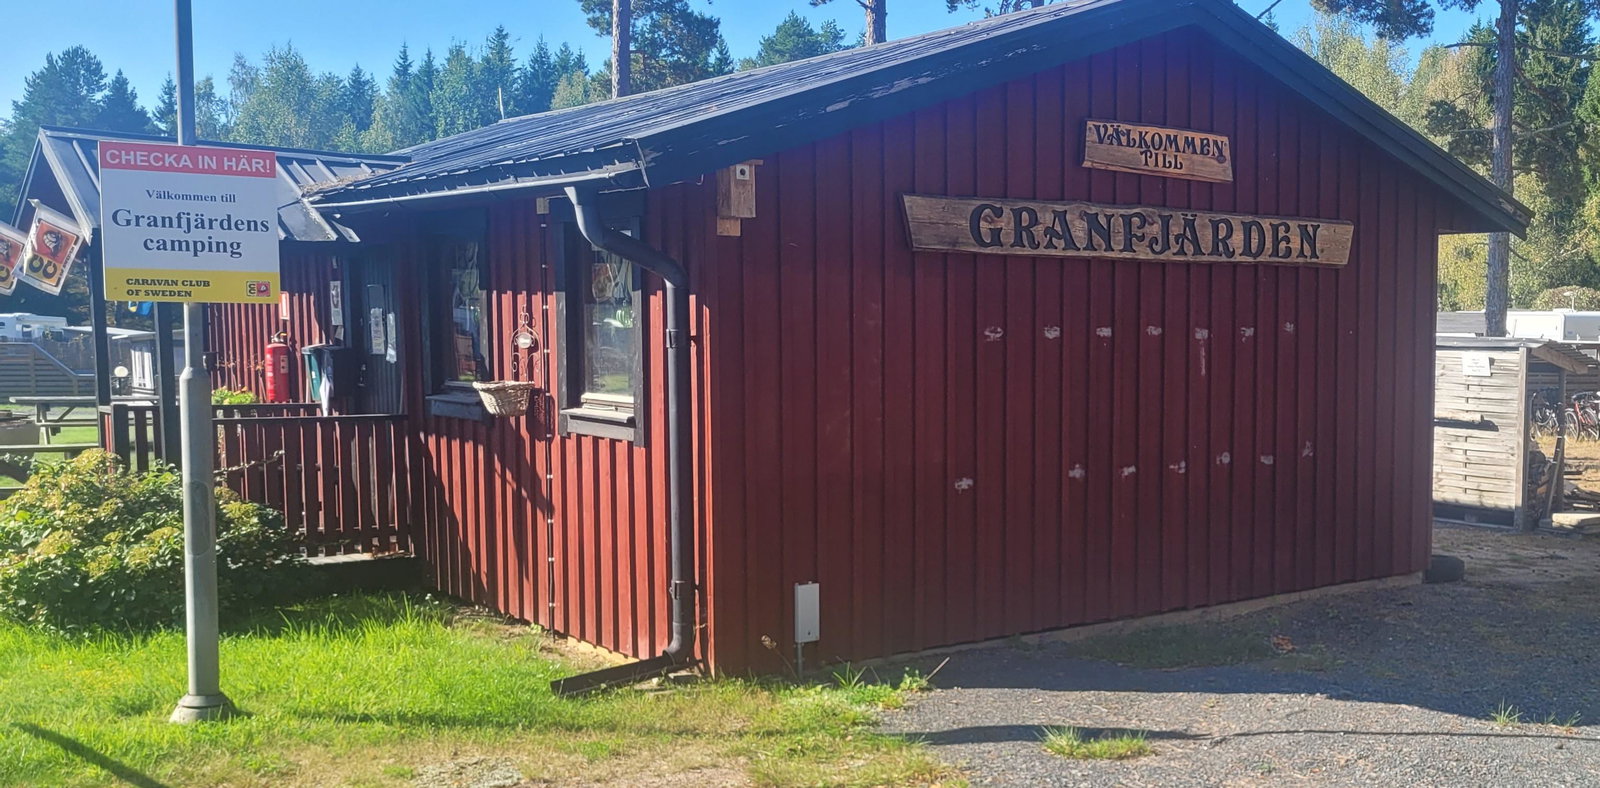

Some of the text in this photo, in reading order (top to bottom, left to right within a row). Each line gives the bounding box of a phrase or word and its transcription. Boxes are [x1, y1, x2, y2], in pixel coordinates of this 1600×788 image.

[1093, 123, 1228, 159] VÄLKOMMEN
[105, 149, 271, 173] CHECKA IN HÄR!
[1139, 149, 1184, 171] TILL
[145, 189, 236, 203] Välkommen till
[111, 208, 270, 234] Granfjärdens
[968, 202, 1321, 261] GRANFJÄRDEN
[143, 236, 243, 259] camping
[126, 278, 211, 288] CARAVAN CLUB
[126, 289, 192, 298] OF SWEDEN
